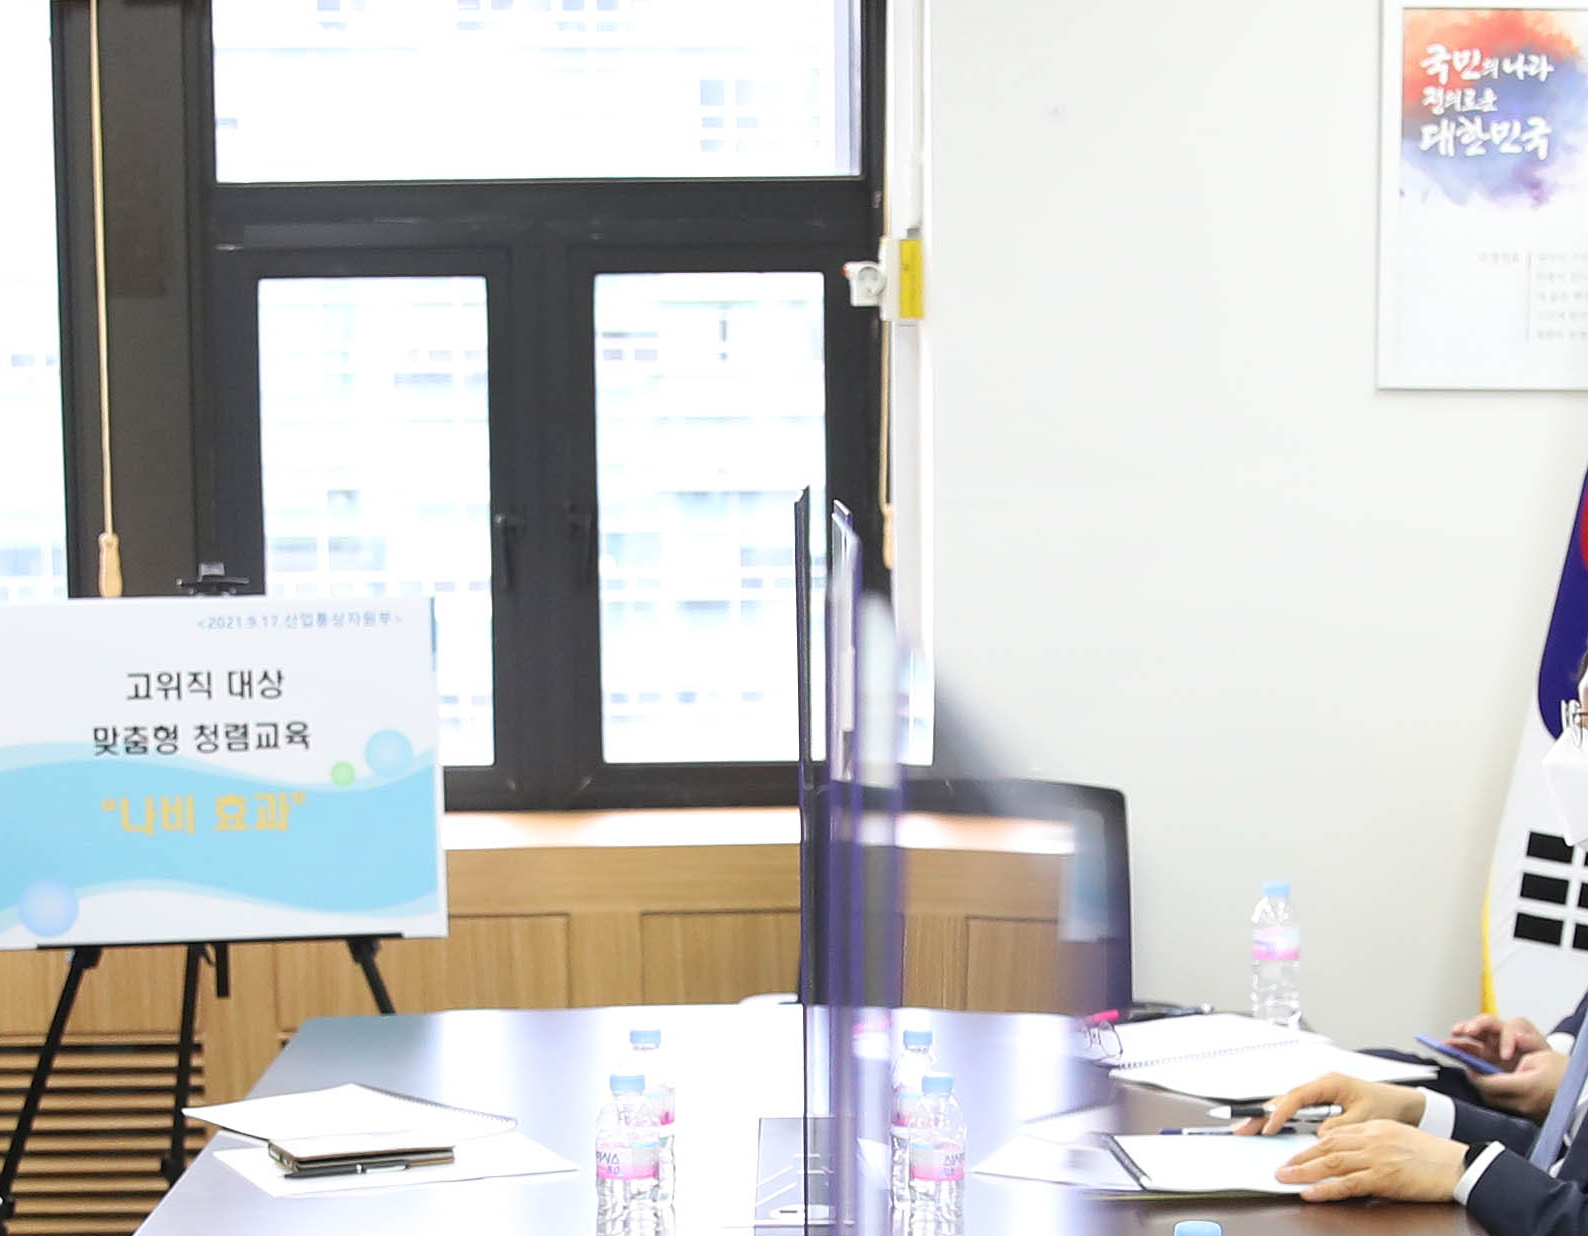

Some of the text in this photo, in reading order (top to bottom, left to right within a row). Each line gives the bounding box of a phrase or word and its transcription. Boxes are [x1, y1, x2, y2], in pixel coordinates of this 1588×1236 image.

[1502, 53, 1556, 82] 나라
[1419, 115, 1553, 160] 대한민국
[126, 669, 285, 701] 고위직 대상
[93, 721, 311, 756] 맞춤형 청렴교육
